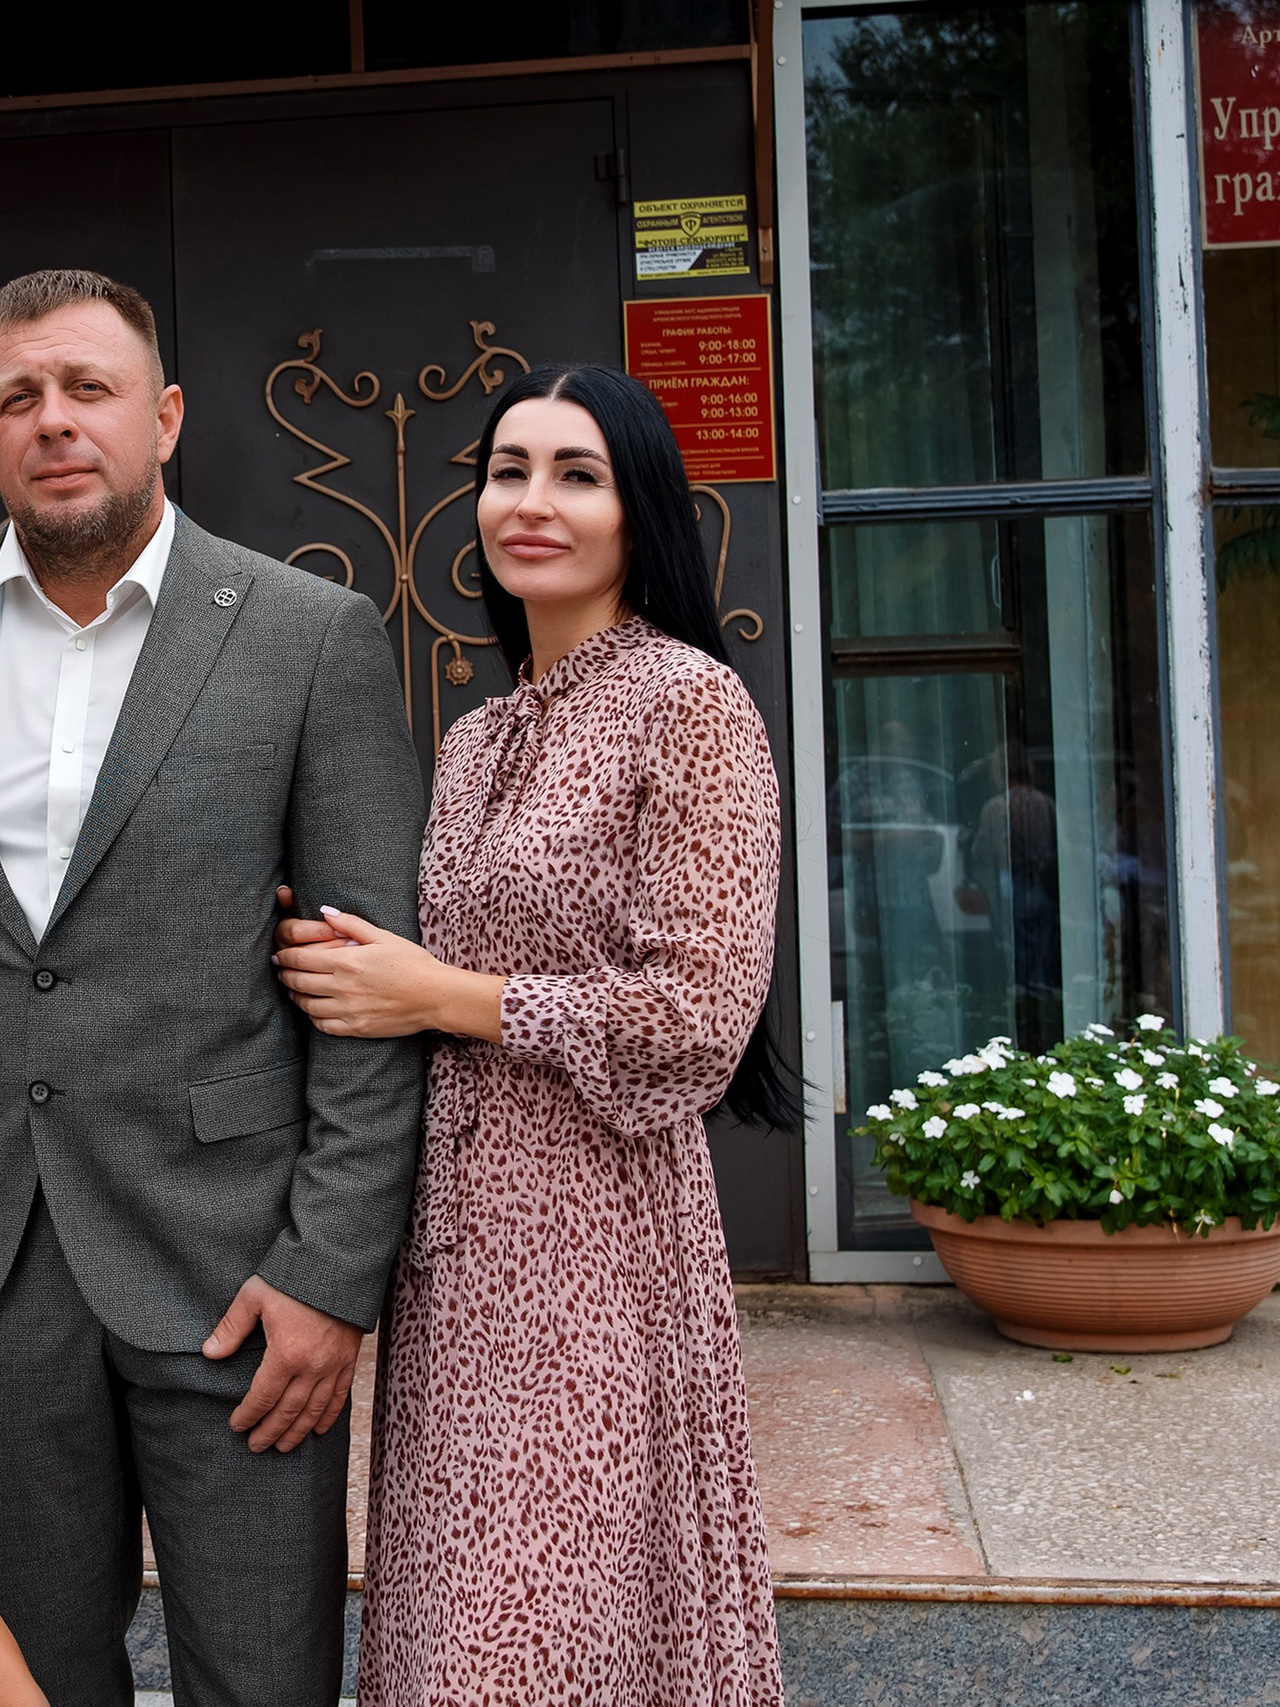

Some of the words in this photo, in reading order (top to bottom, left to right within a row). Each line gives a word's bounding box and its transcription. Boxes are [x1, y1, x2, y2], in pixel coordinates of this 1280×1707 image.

[1210, 97, 1280, 150] Упр
[1214, 171, 1280, 216] гра
[638, 203, 678, 213] ОБЪЕКТ
[680, 198, 745, 211] ОХРАНЯЕТСЯ
[636, 218, 679, 229] ОХРАННЫМ
[662, 328, 696, 337] ГРАФИК
[696, 326, 733, 336] РАБОТЫ:
[698, 338, 756, 351] 9:00-18:00
[699, 352, 757, 365] 9:00-17:00
[649, 377, 689, 390] ПРИЁМ
[690, 375, 750, 389] ГРАЖДАН:
[700, 392, 758, 405] 9:00-16:00
[701, 406, 758, 419] 9:00-13:00
[695, 427, 759, 441] 13:00-14:00
